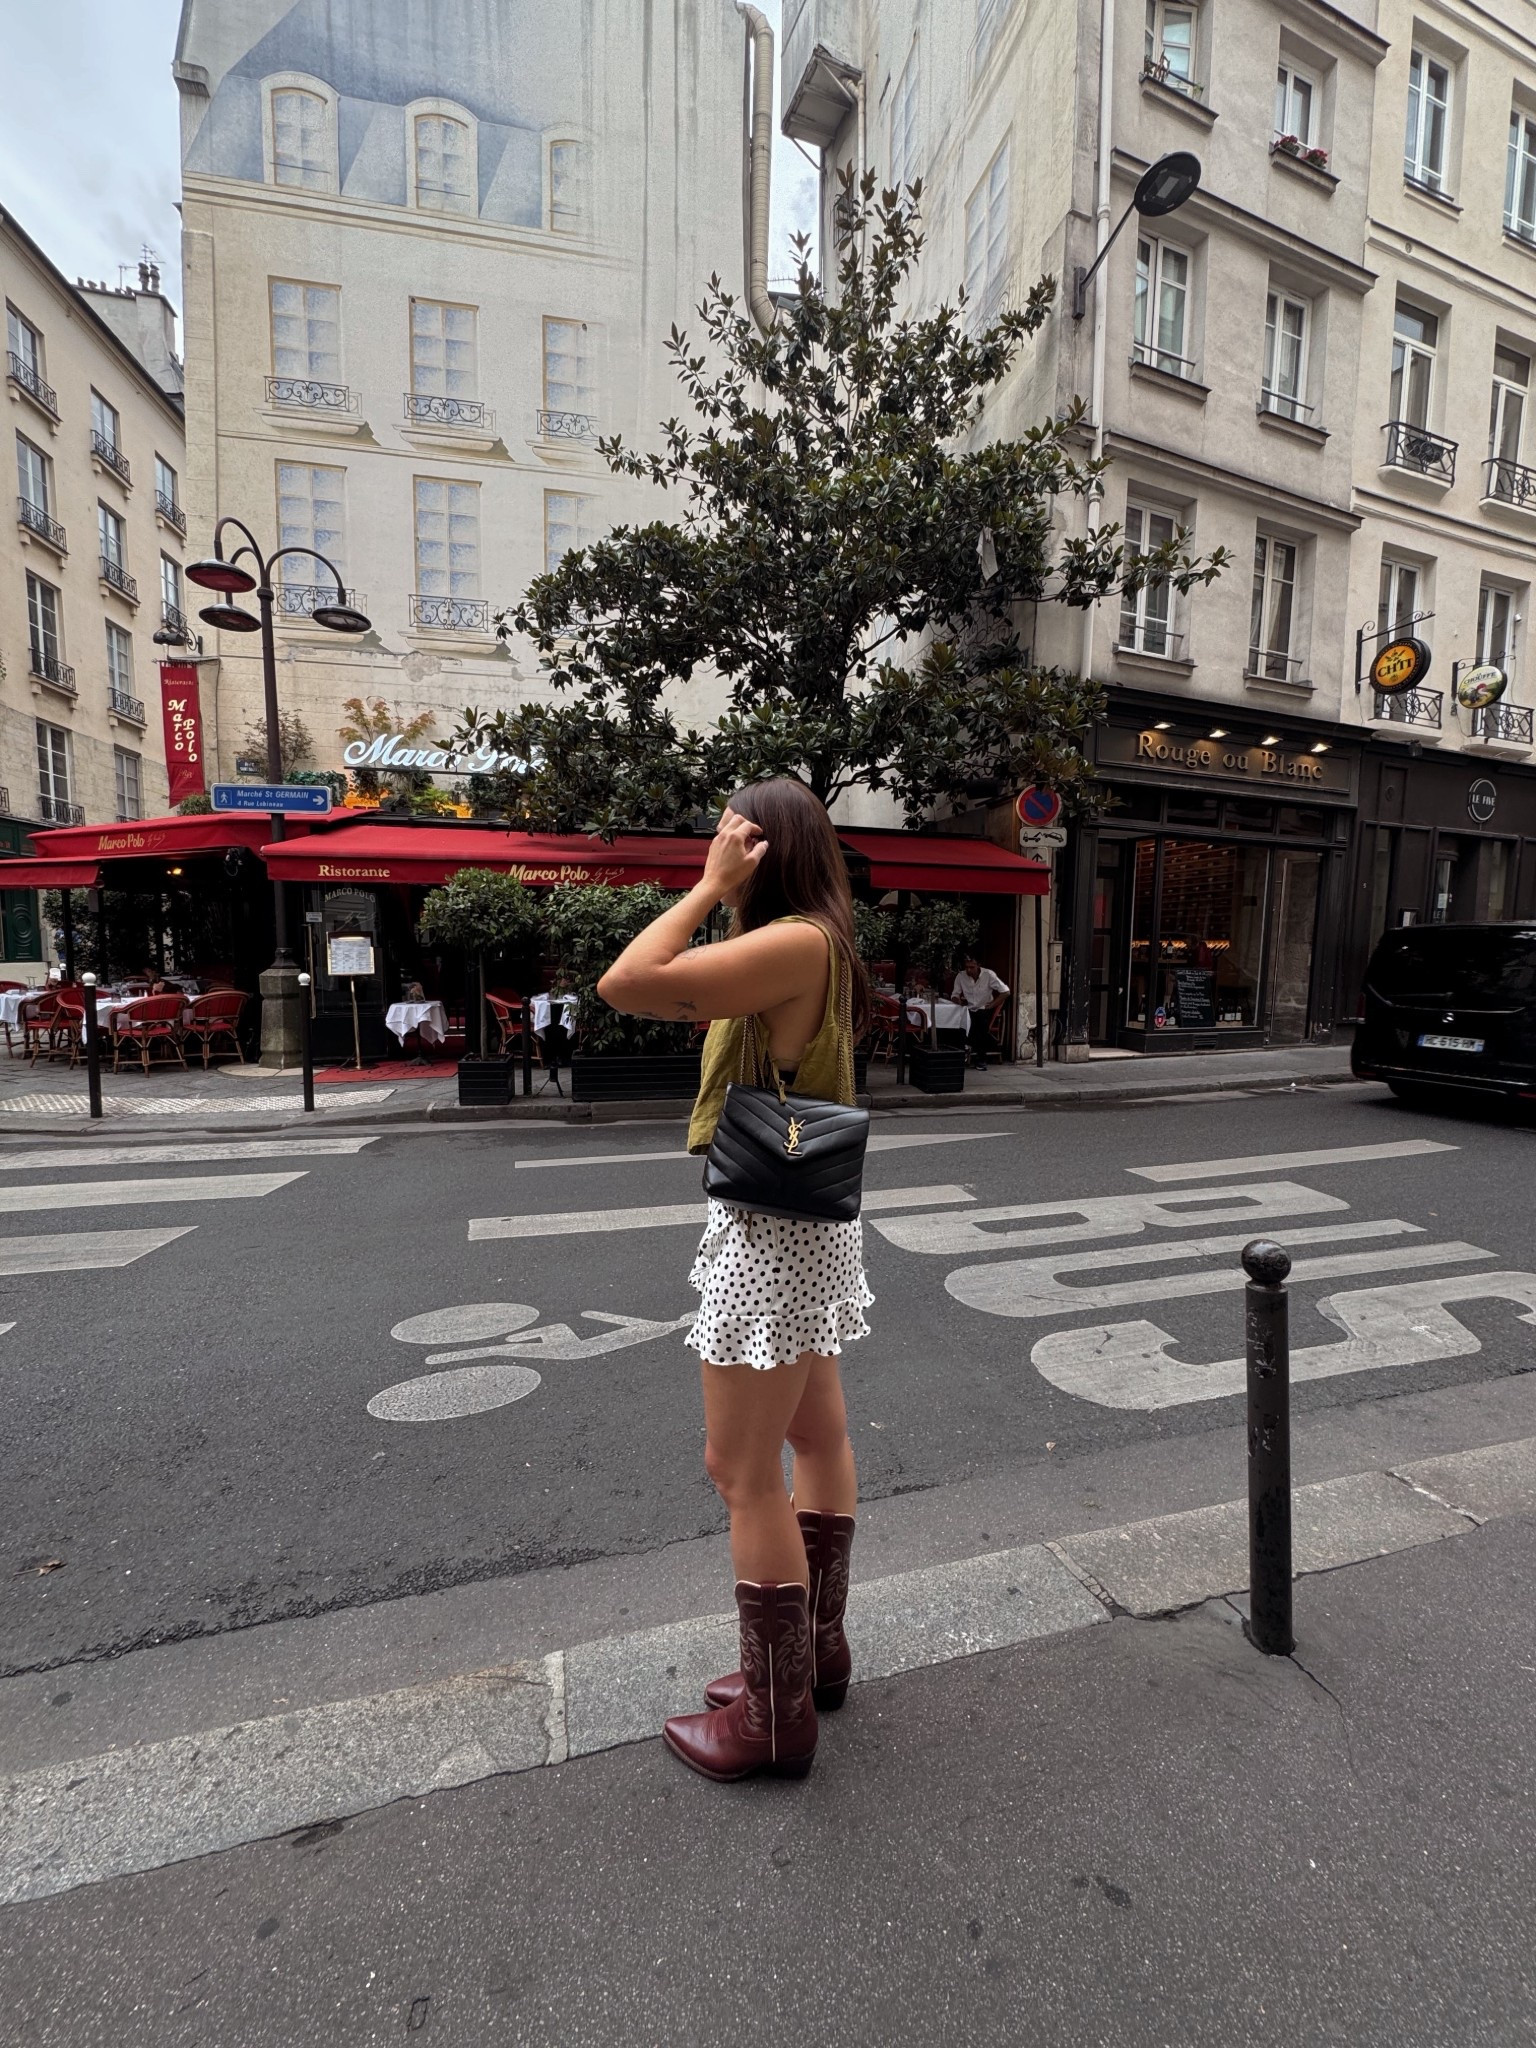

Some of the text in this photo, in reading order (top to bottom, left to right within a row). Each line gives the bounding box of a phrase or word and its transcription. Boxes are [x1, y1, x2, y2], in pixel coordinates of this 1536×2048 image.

[168, 699, 187, 751] Marco
[183, 719, 198, 762] Polo
[1136, 733, 1323, 779] Rouge ou Blanc
[236, 790, 309, 799] Marché St GERMAIN
[1472, 794, 1480, 804] LE
[98, 835, 127, 851] Marco
[127, 833, 145, 848] Polo
[318, 864, 391, 878] Ristorante
[510, 864, 559, 881] Marco
[560, 865, 590, 881] Polo
[324, 887, 376, 903] MARCO POLO
